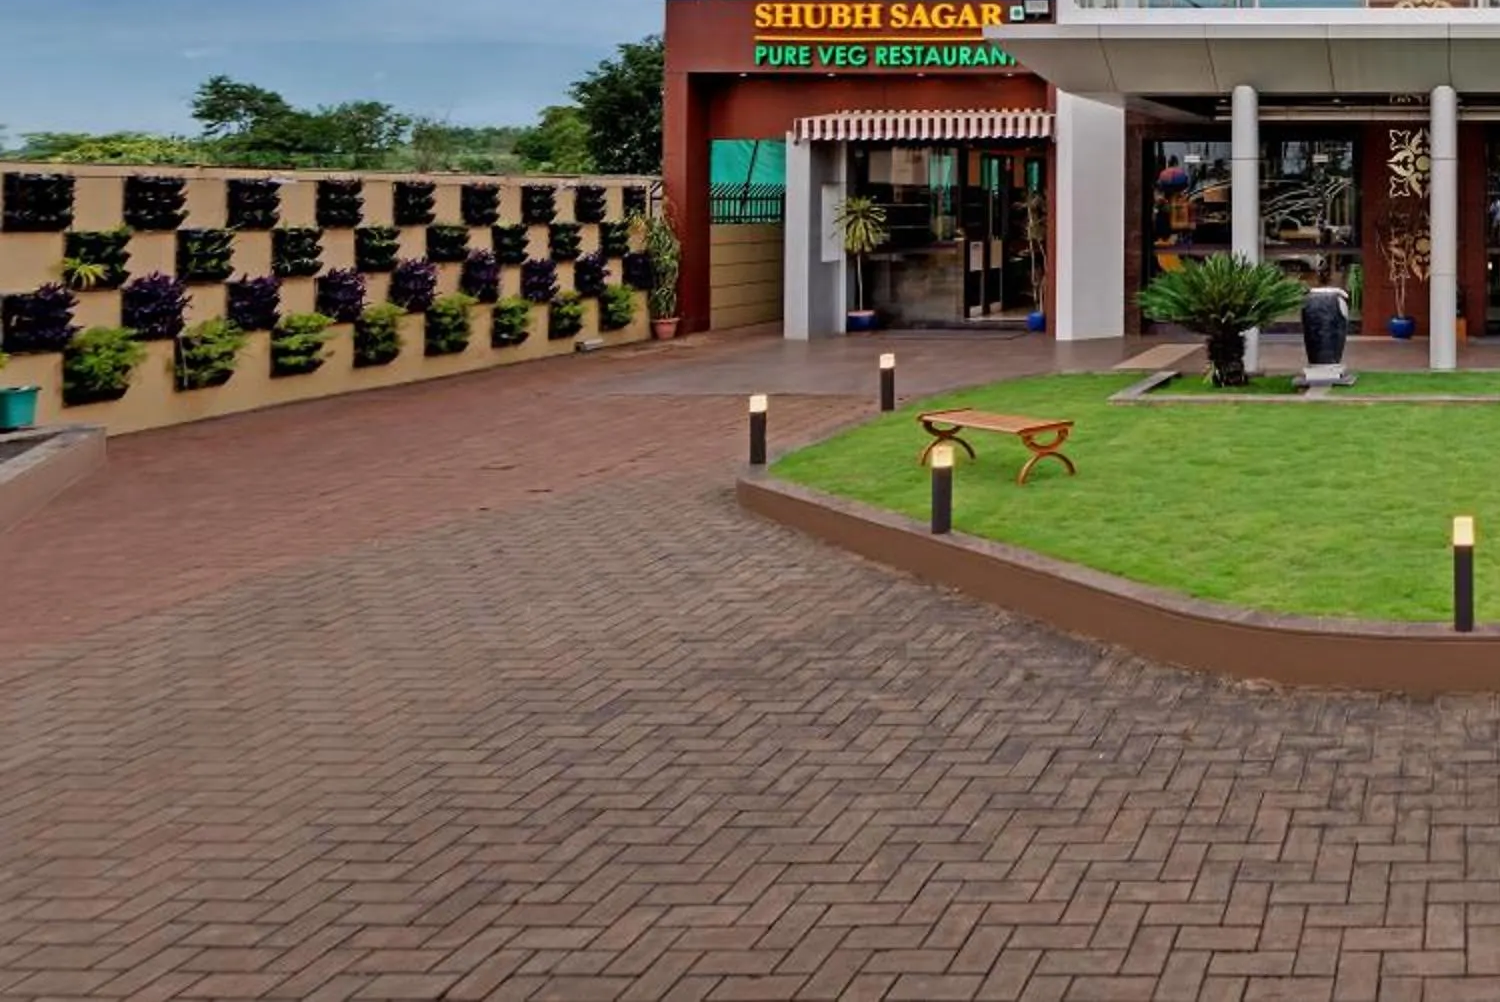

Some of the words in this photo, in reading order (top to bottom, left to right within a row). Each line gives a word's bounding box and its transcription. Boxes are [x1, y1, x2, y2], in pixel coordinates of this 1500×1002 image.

[754, 3, 882, 29] SHUBH
[890, 3, 1003, 28] SAGAR
[754, 45, 812, 67] PURE
[817, 45, 868, 67] VEG
